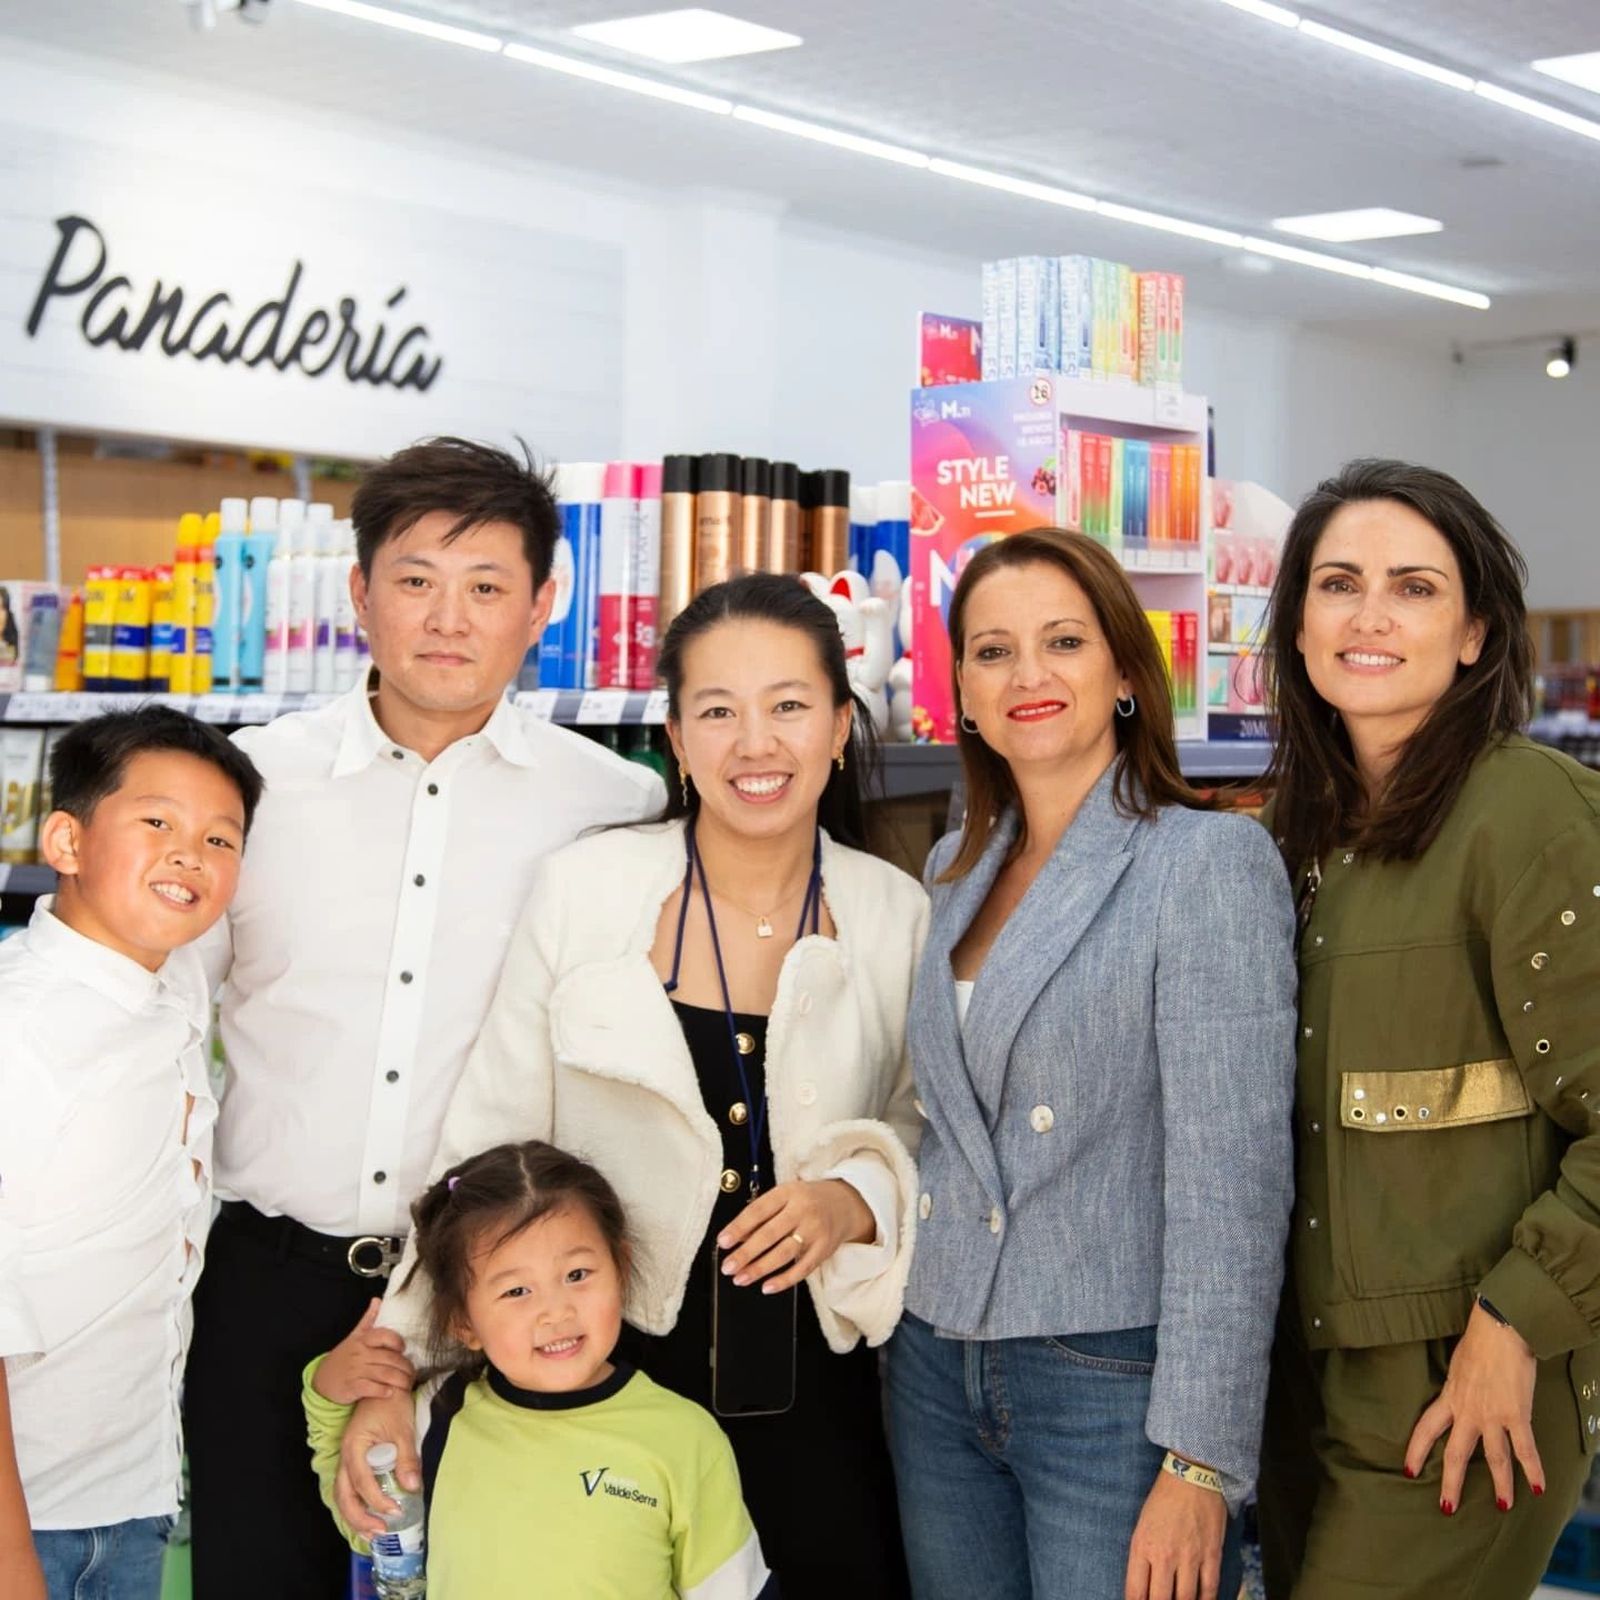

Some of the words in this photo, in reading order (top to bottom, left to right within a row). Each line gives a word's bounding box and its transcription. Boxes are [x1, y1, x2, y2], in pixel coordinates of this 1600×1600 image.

[25, 215, 442, 392] Panadería
[936, 455, 1010, 485] STYLE
[960, 481, 1017, 509] NEW
